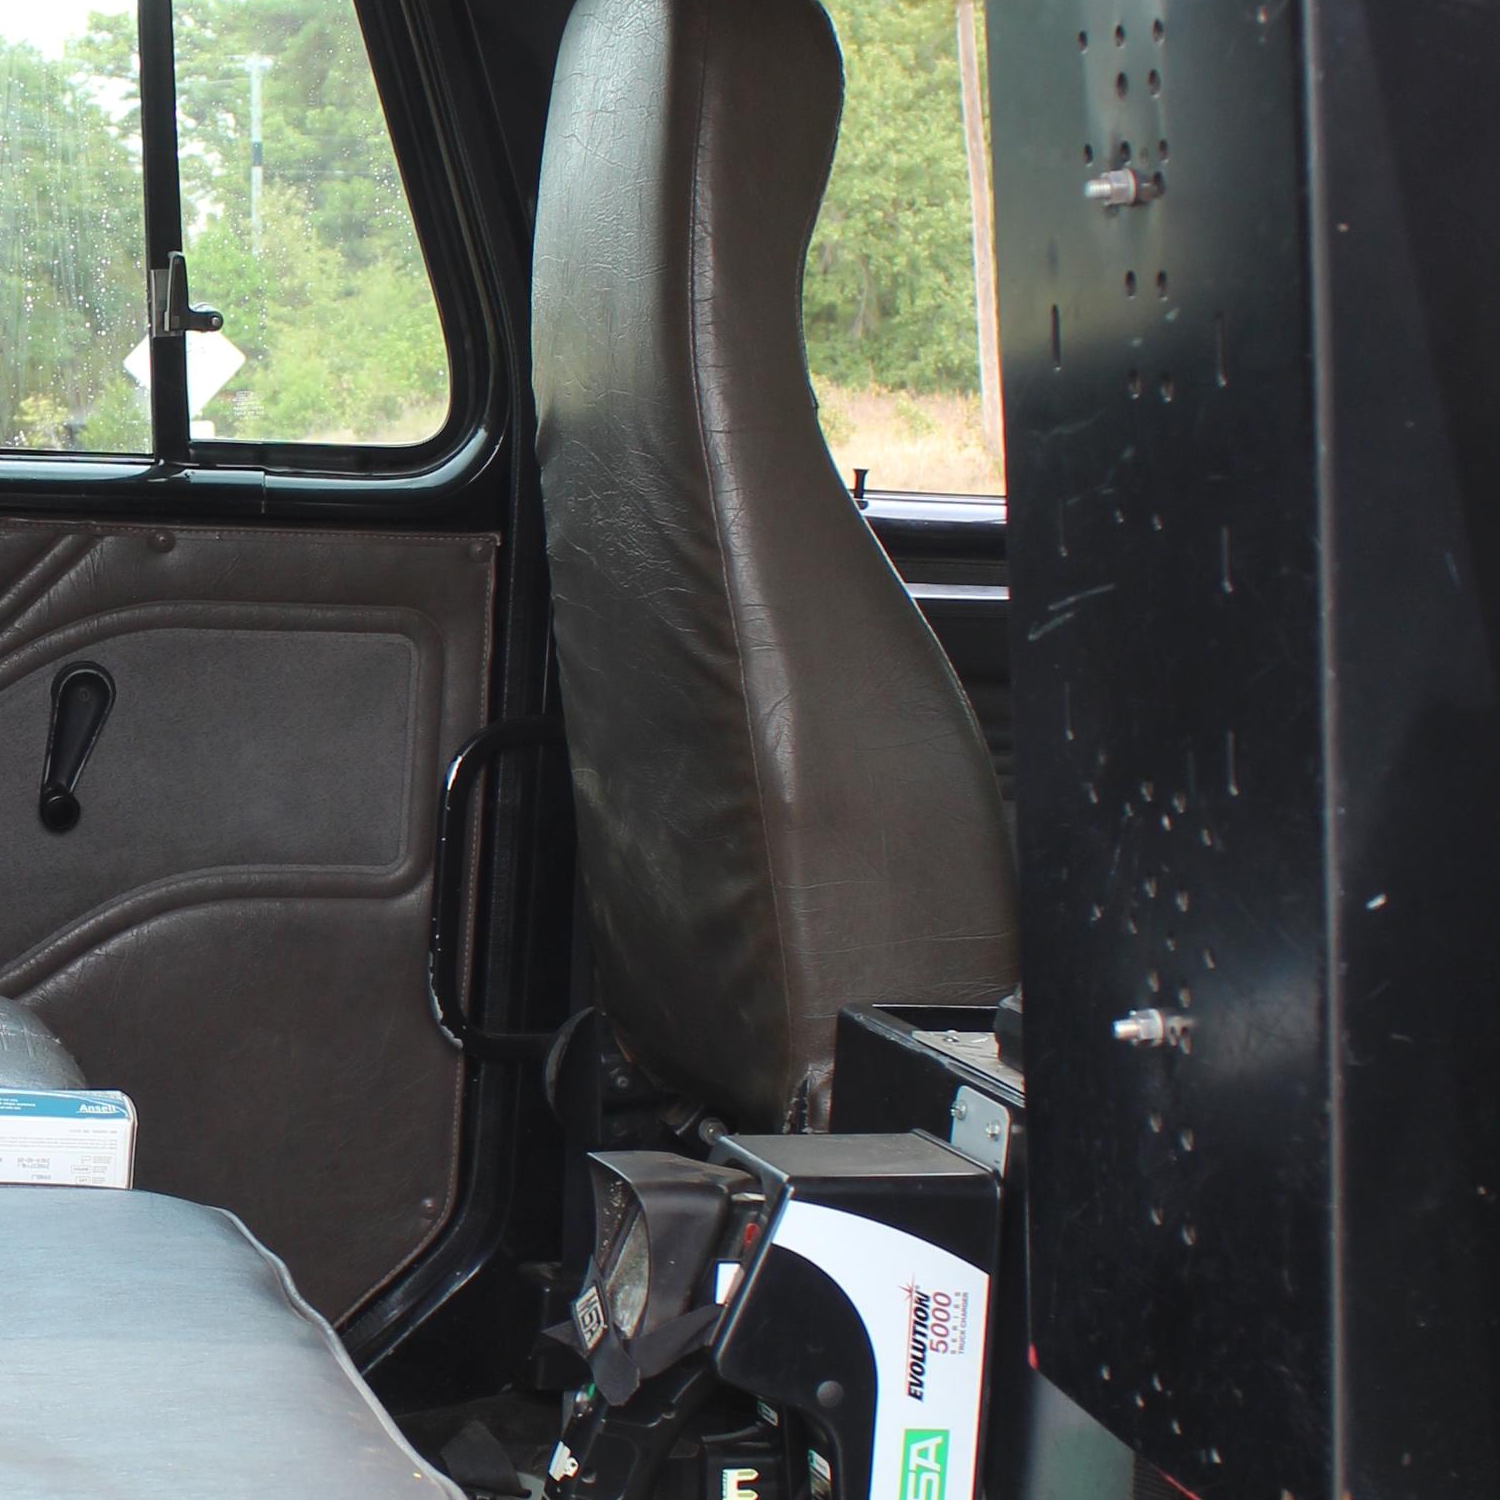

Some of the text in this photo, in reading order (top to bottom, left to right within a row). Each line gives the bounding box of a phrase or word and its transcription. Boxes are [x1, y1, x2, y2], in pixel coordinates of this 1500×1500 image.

[79, 1103, 117, 1114] Ansell
[907, 1290, 930, 1402] EVOLUTION
[929, 1291, 952, 1355] 5000
[958, 1292, 969, 1355] TRUCK CHARGER
